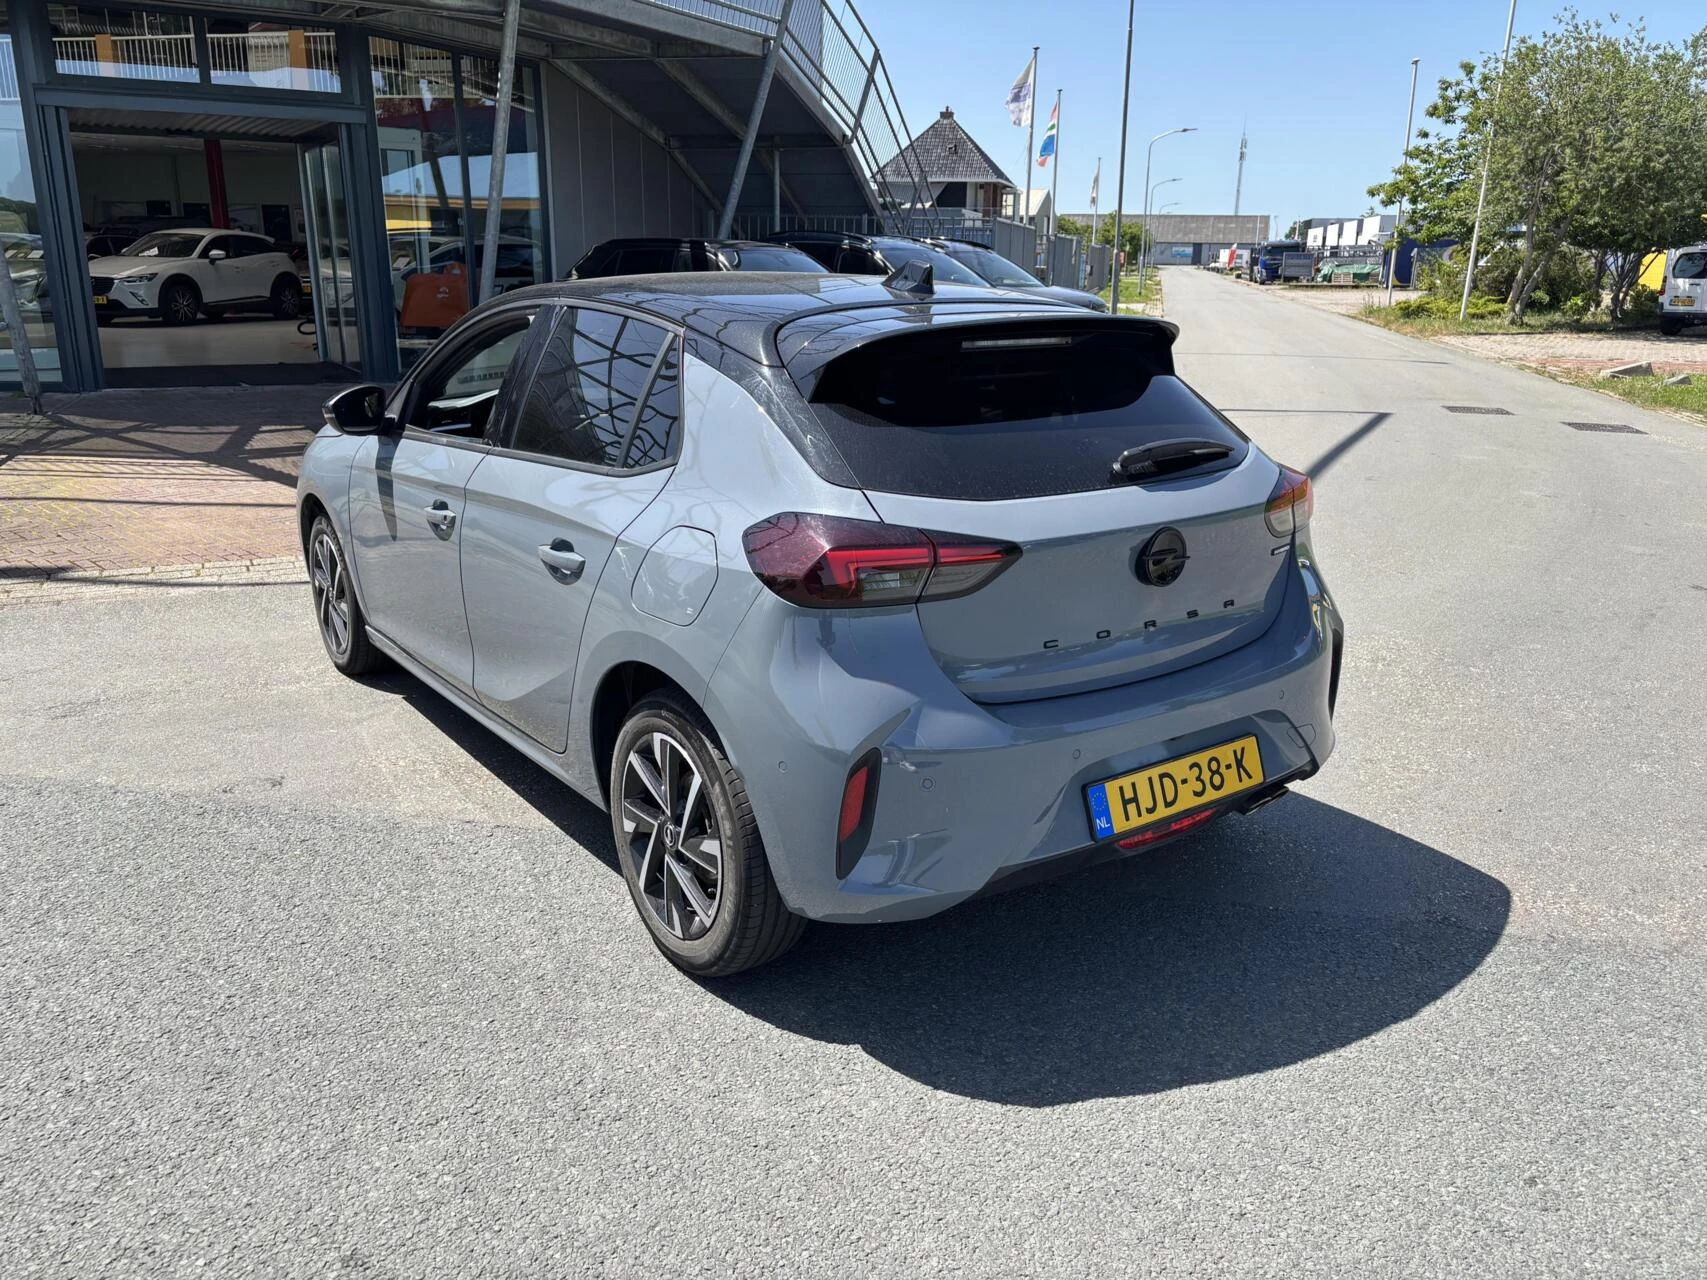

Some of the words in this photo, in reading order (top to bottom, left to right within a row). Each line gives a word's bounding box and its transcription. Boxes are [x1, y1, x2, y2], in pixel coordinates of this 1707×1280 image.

[1043, 599, 1235, 650] CORSA
[1118, 746, 1254, 822] HJD-38-K
[1096, 816, 1111, 831] NL
